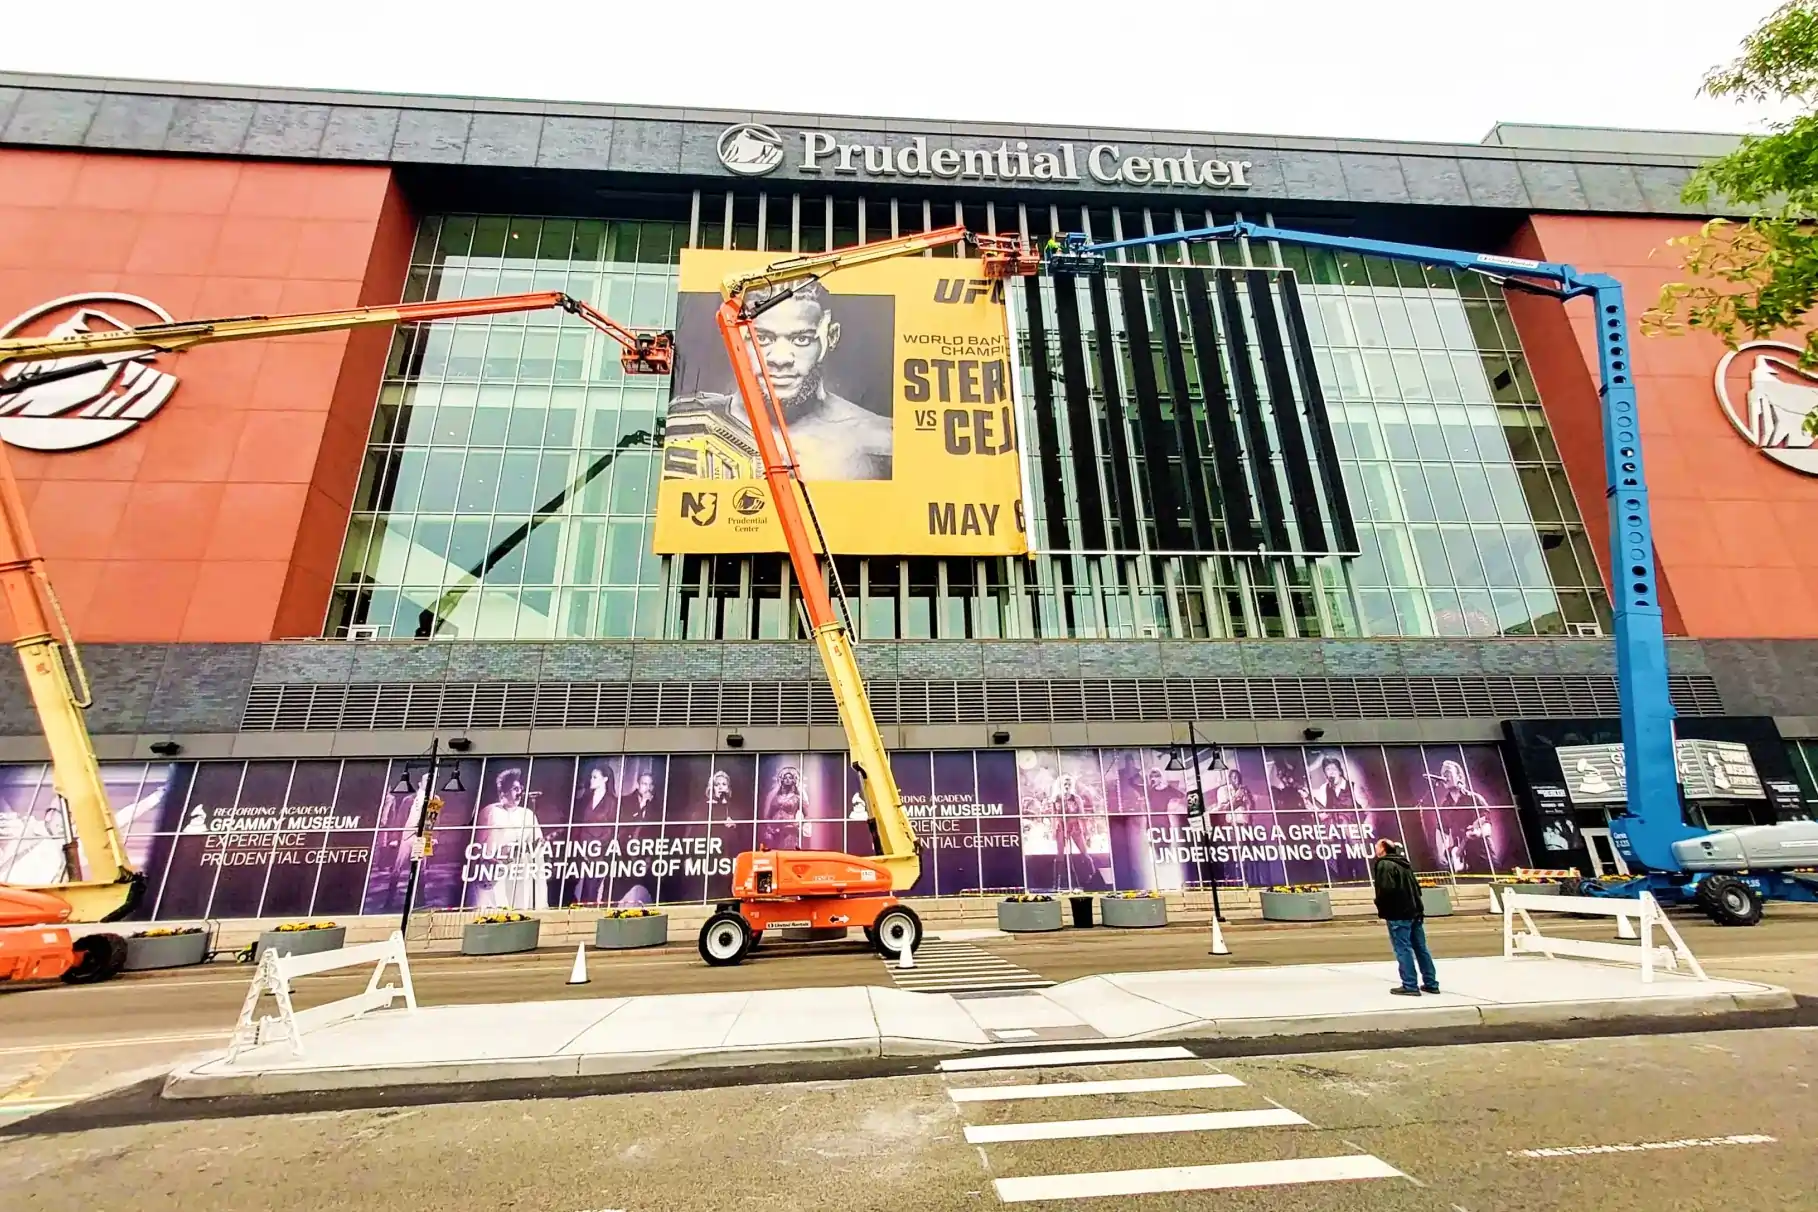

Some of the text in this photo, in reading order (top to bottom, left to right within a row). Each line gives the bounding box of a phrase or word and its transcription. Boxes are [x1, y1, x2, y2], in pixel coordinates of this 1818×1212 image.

[799, 132, 1252, 190] Prudential Center
[903, 334, 963, 345] WORLD
[903, 359, 1007, 404] STER
[915, 410, 937, 427] VS
[928, 502, 1000, 536] MAY
[930, 794, 974, 803] ACADEMY
[213, 806, 332, 816] RECORDING ACADEMY
[940, 804, 1003, 816] MUSEUM
[210, 816, 361, 831] GRAMMY MUSEUM
[1270, 825, 1287, 840] A
[1288, 823, 1375, 840] GREATER
[205, 833, 306, 848] EXPERIENCE
[465, 837, 722, 860] CULTIVATING A GREATER
[963, 835, 1020, 848] CENTER
[200, 850, 369, 867] PRUDENTIAL CENTER
[1149, 843, 1313, 864] UNDERSTANDING
[1316, 843, 1342, 860] OF
[461, 860, 647, 882] UNDERSTANDING
[651, 859, 681, 877] OF
